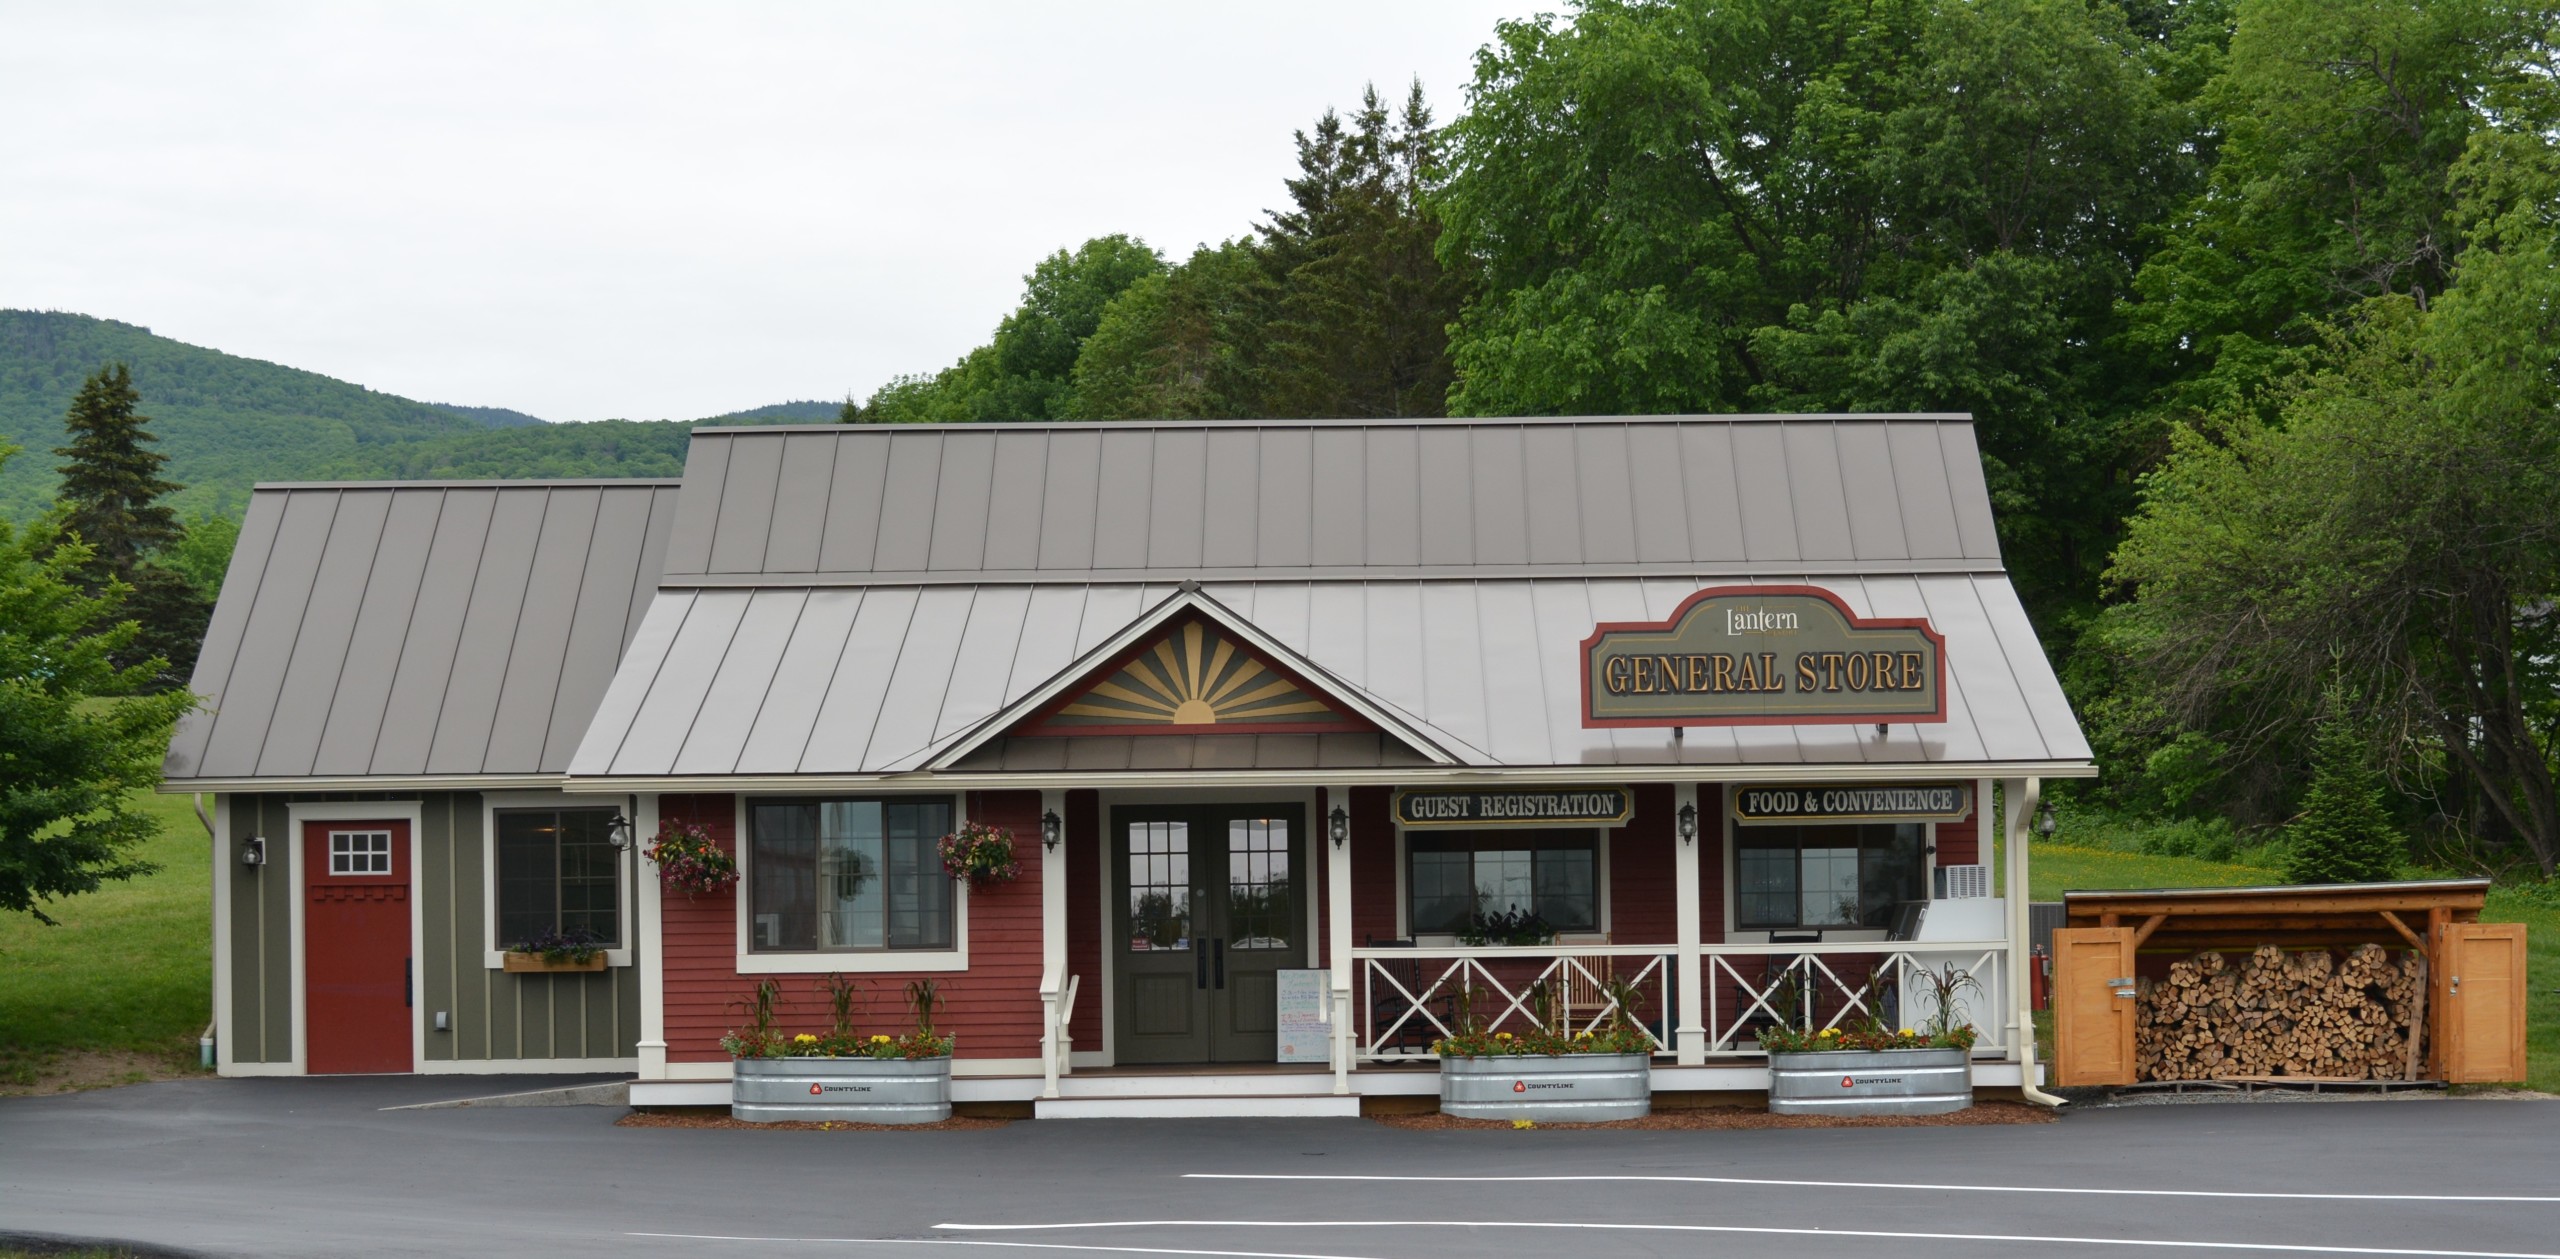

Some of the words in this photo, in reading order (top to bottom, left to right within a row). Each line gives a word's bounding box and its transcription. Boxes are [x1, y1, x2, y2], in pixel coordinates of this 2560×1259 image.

[1727, 605, 1799, 636] Lantern
[1605, 652, 1784, 694] GENERAL
[1798, 652, 1923, 692] STORE
[1411, 796, 1470, 818] GUEST
[1480, 794, 1614, 817] REGISTRATION
[1749, 791, 1799, 813] FOOD
[1804, 792, 1818, 812] &
[1823, 789, 1953, 812] CONVENIENCE
